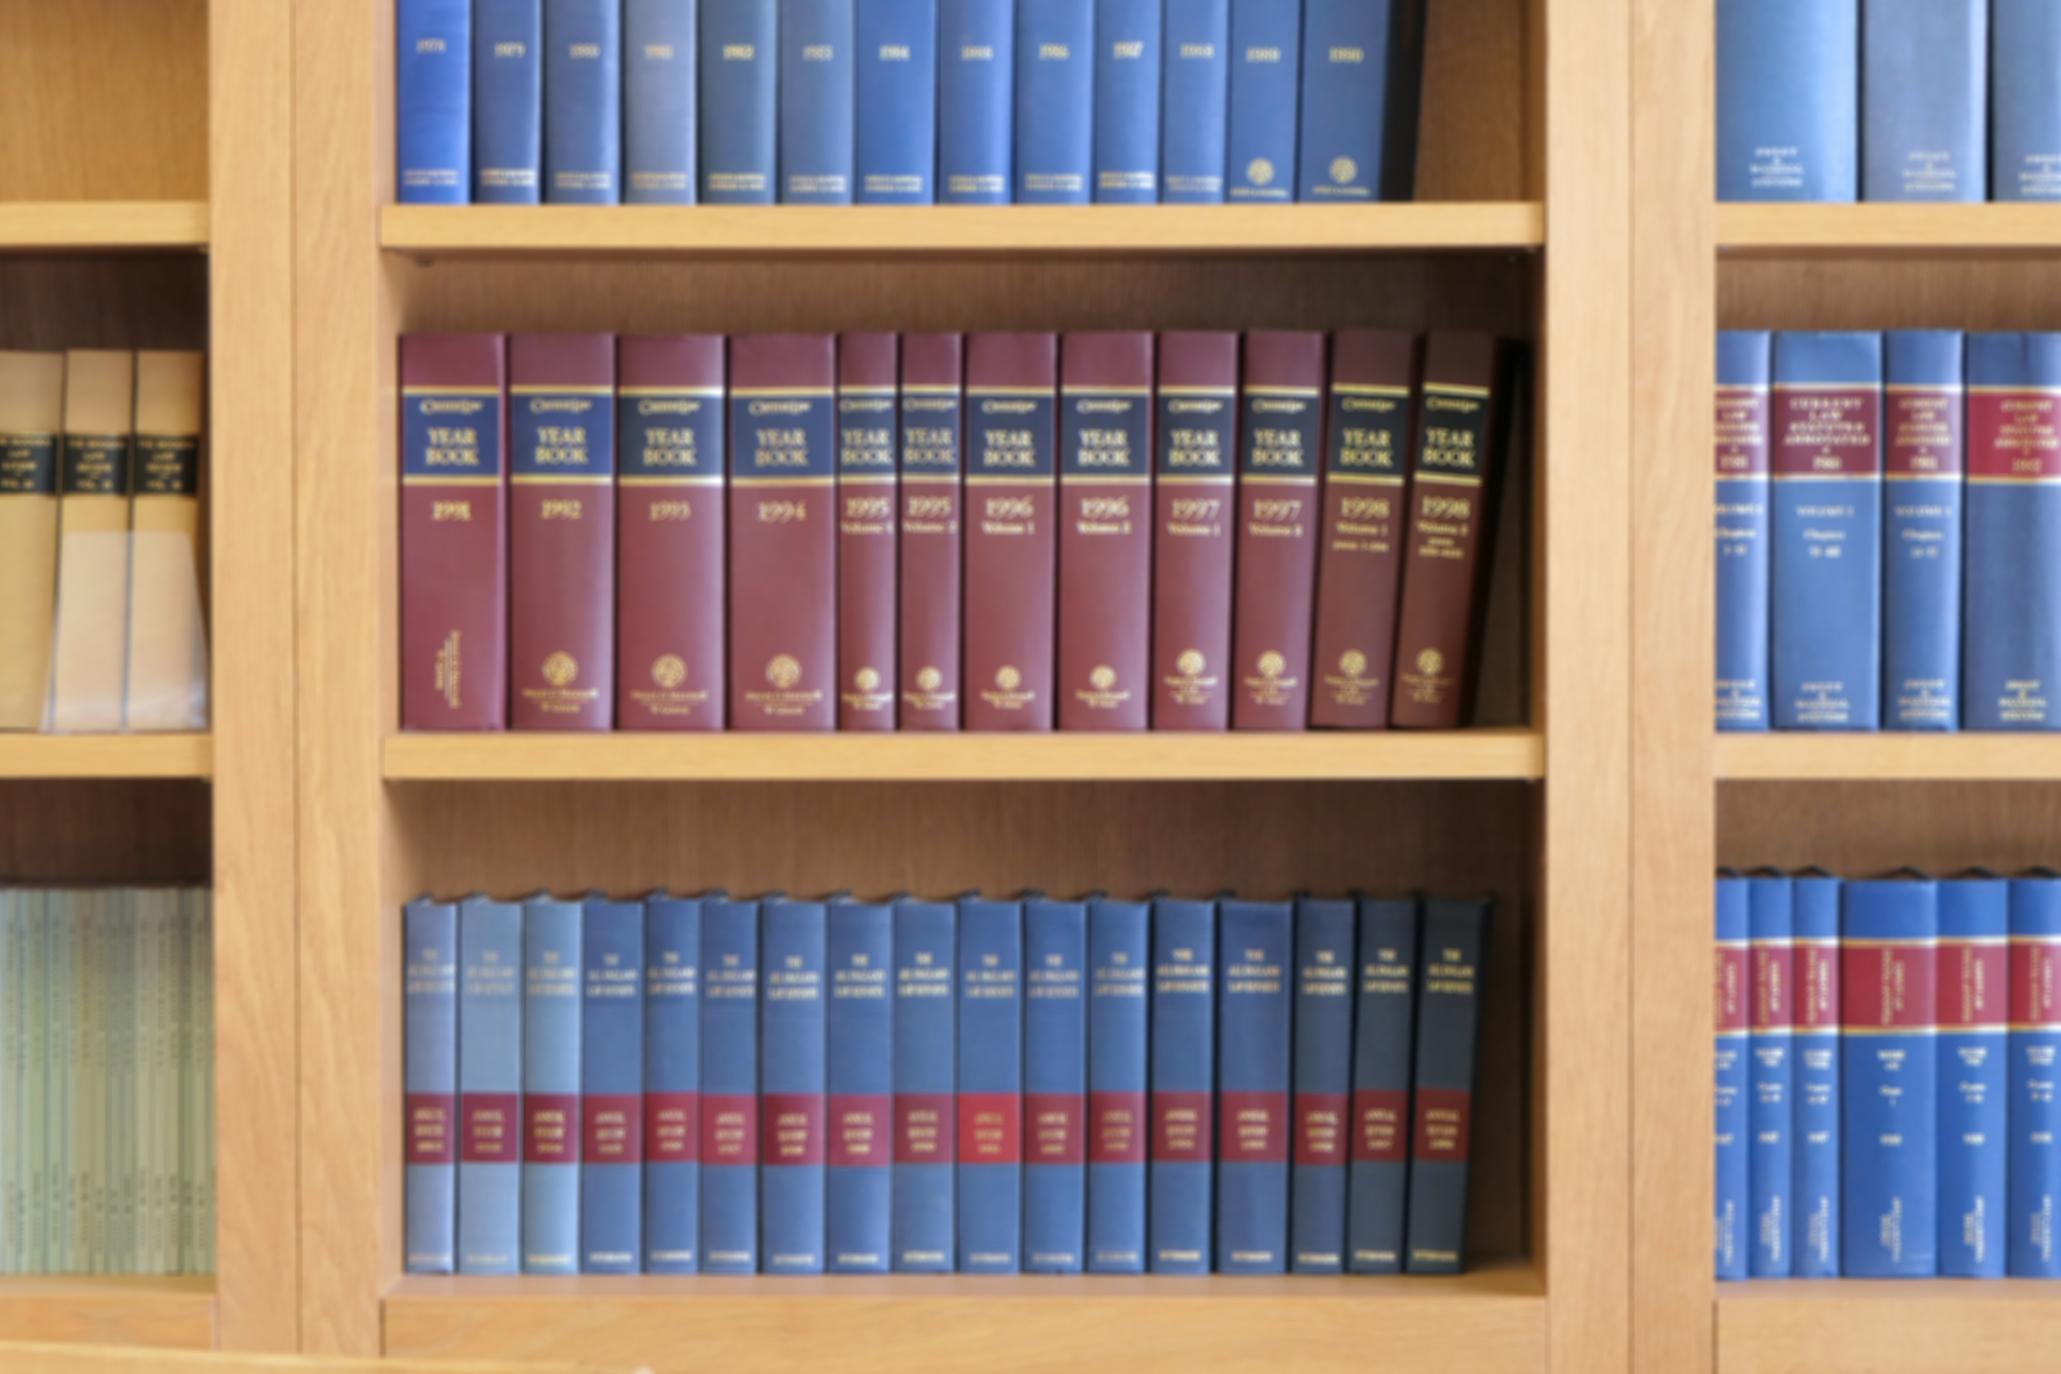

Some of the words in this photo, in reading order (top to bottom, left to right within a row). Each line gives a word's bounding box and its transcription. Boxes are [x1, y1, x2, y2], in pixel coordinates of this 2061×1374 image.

[428, 428, 477, 445] YEAR
[538, 428, 585, 444] YEAR
[646, 429, 694, 445] YEAR
[757, 430, 805, 446] YEAR
[843, 430, 888, 445] YEAR
[907, 430, 951, 445] YEAR
[985, 431, 1031, 446] YEAR
[1080, 430, 1127, 447] YEAR
[1172, 431, 1217, 447] YEAR
[1255, 431, 1301, 447] YEAR
[1344, 430, 1390, 447] YEAR
[1427, 430, 1472, 447] YEAR
[426, 447, 478, 465] BOOK
[537, 446, 588, 464] BOOK
[644, 447, 695, 465] BOOK
[756, 448, 808, 466] BOOK
[843, 448, 892, 464] BOOK
[904, 448, 955, 464] BOOK
[985, 448, 1035, 466] BOOK
[1079, 449, 1129, 465] BOOK
[1170, 449, 1221, 465] BOOK
[1253, 449, 1303, 465] BOOK
[1341, 449, 1392, 466] BOOK
[1424, 448, 1474, 466] BOOK
[432, 501, 470, 520] 1991
[541, 501, 581, 519] 1992
[649, 502, 690, 521] 1993
[758, 501, 806, 522] 1994
[847, 497, 888, 517] 1995
[908, 497, 950, 517] 1995
[986, 497, 1033, 517] 1996
[1081, 497, 1128, 518] 1996
[1172, 499, 1220, 520] 1997
[1254, 500, 1302, 521] 1997
[1341, 498, 1389, 518] 1998
[1422, 497, 1469, 517] 1998
